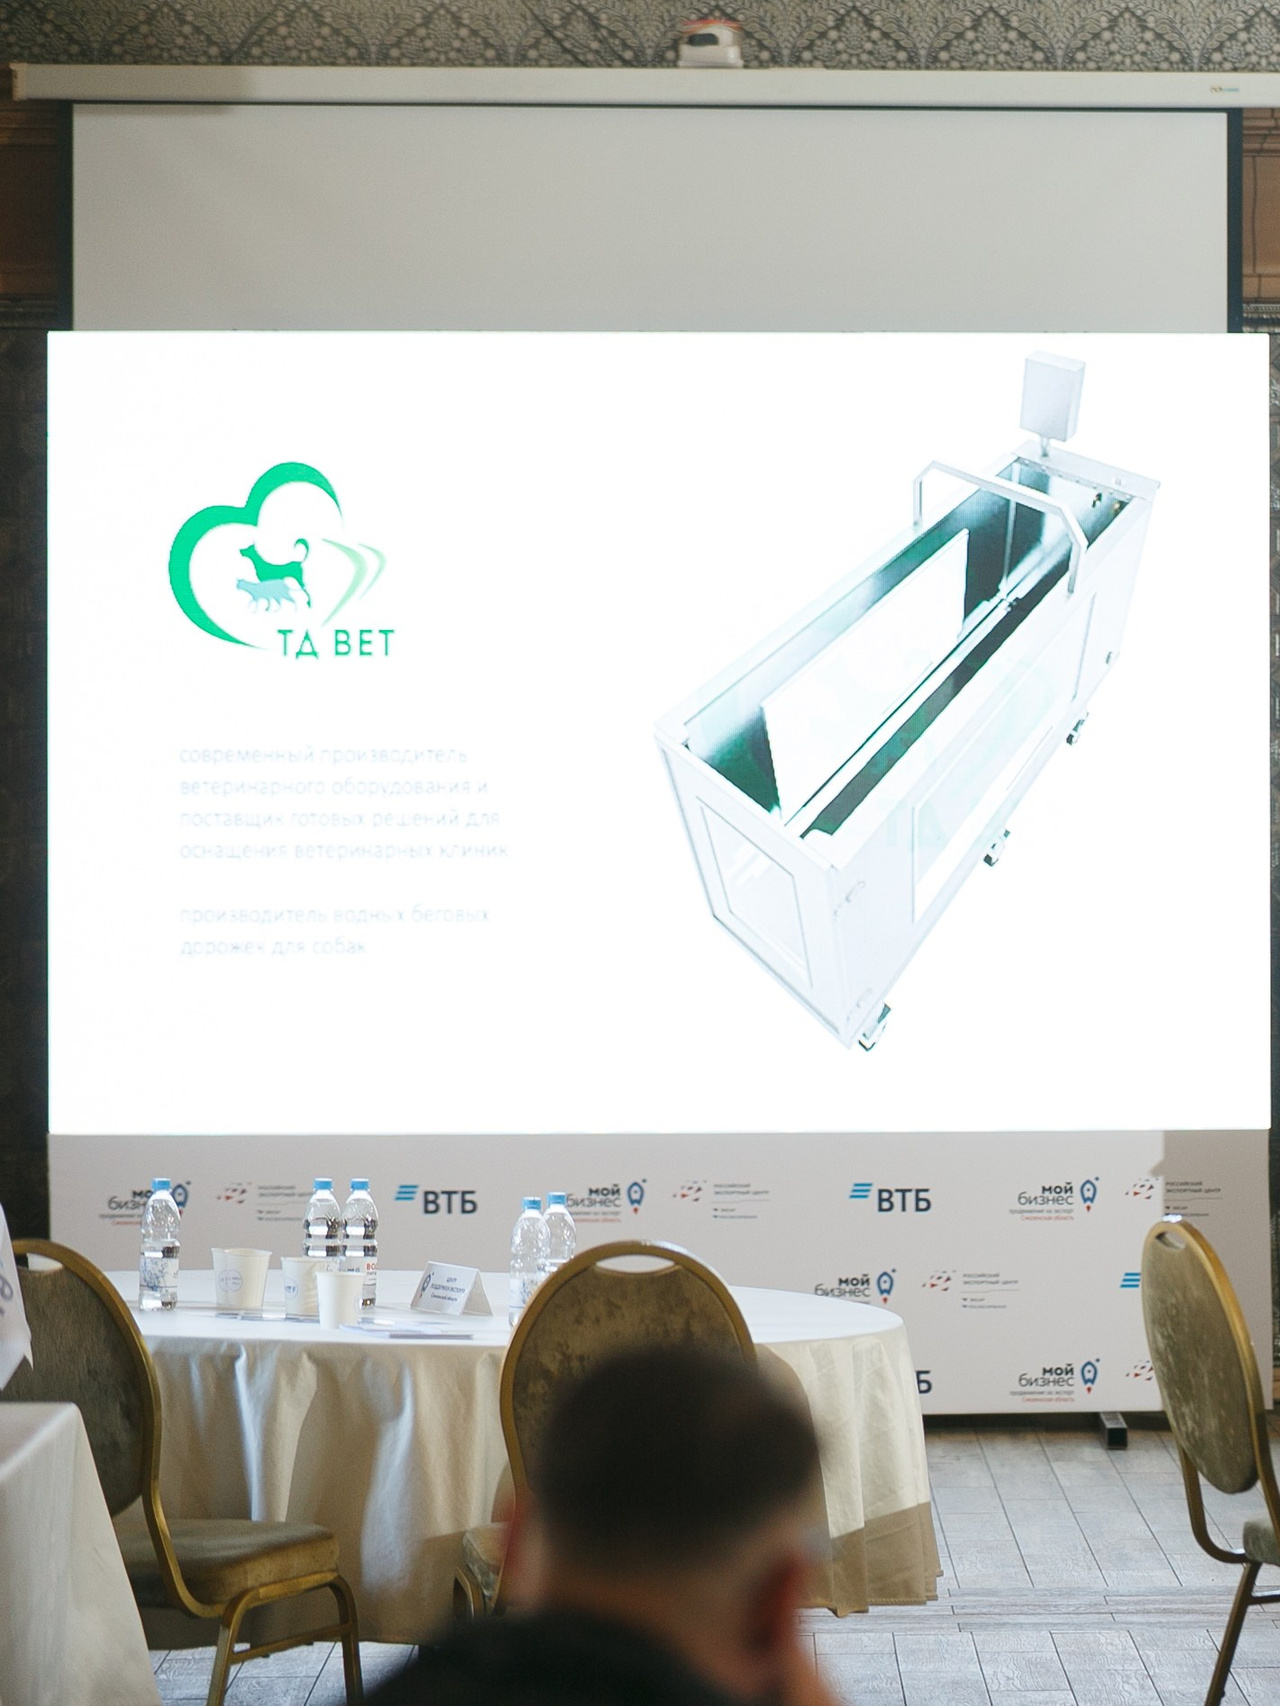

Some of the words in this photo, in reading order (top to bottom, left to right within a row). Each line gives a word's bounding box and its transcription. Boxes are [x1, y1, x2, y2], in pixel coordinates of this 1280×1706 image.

[334, 629, 395, 657] ВЕТ
[180, 745, 314, 765] современный
[320, 748, 468, 766] производитель
[179, 780, 325, 798] ветеринарного
[331, 776, 472, 798] оборудования
[478, 781, 488, 794] и
[180, 812, 284, 831] поставщик
[291, 812, 365, 828] готовых
[372, 808, 460, 830] решений
[464, 812, 500, 831] для
[180, 845, 287, 862] оснащения
[294, 845, 433, 862] ветеринарных
[440, 844, 508, 860] клиник
[180, 907, 327, 928] производитель
[333, 907, 406, 926] водных
[411, 903, 490, 924] беговых
[179, 940, 266, 960] дорожек
[271, 940, 306, 959] для
[312, 936, 367, 957] собак
[132, 1190, 154, 1199] мо
[588, 1183, 621, 1197] мой
[1041, 1181, 1074, 1195] мой
[108, 1195, 147, 1211] бизн
[423, 1190, 478, 1215] ВТБ
[566, 1193, 622, 1208] бизнес
[877, 1188, 932, 1213] ВТБ
[1017, 1190, 1074, 1206] бизнес
[838, 1273, 870, 1287] мой
[814, 1283, 871, 1298] бизнес
[1042, 1363, 1074, 1376] мой
[1018, 1372, 1075, 1388] бизнес
